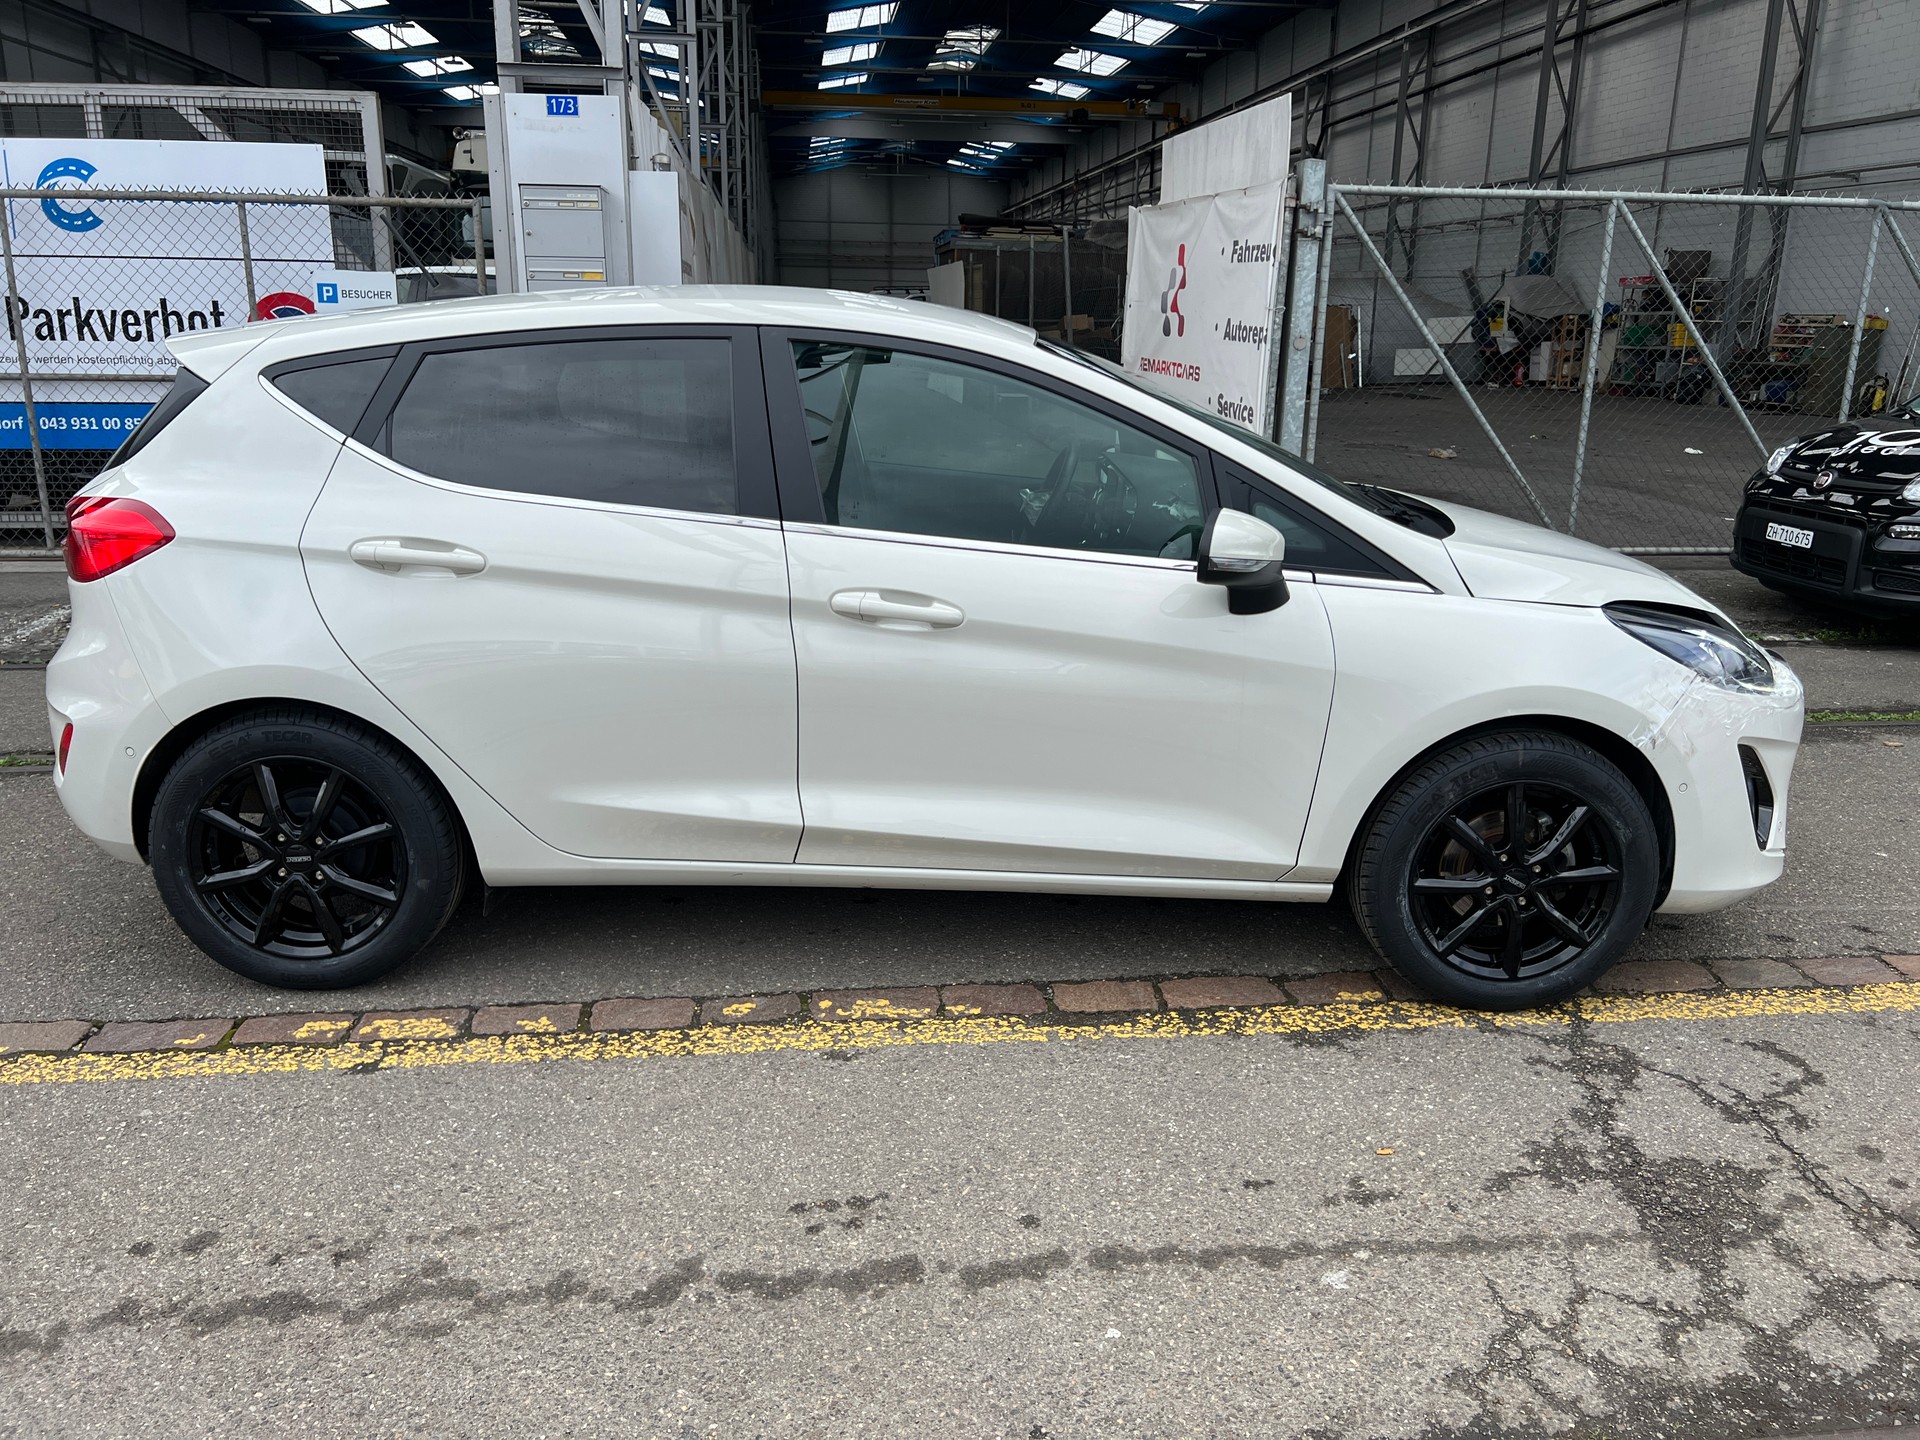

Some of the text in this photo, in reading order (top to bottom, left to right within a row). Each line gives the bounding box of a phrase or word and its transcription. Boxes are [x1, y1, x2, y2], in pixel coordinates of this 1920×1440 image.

[550, 98, 575, 113] 173
[322, 286, 393, 302] P BESUCHER
[34, 355, 74, 365] werden
[77, 355, 154, 367] kostenpflichtig
[1217, 392, 1254, 424] Service
[0, 416, 24, 430] orf
[39, 416, 68, 430] 043
[70, 416, 99, 430] 931
[102, 416, 121, 430] 00
[261, 730, 313, 745] TECAR
